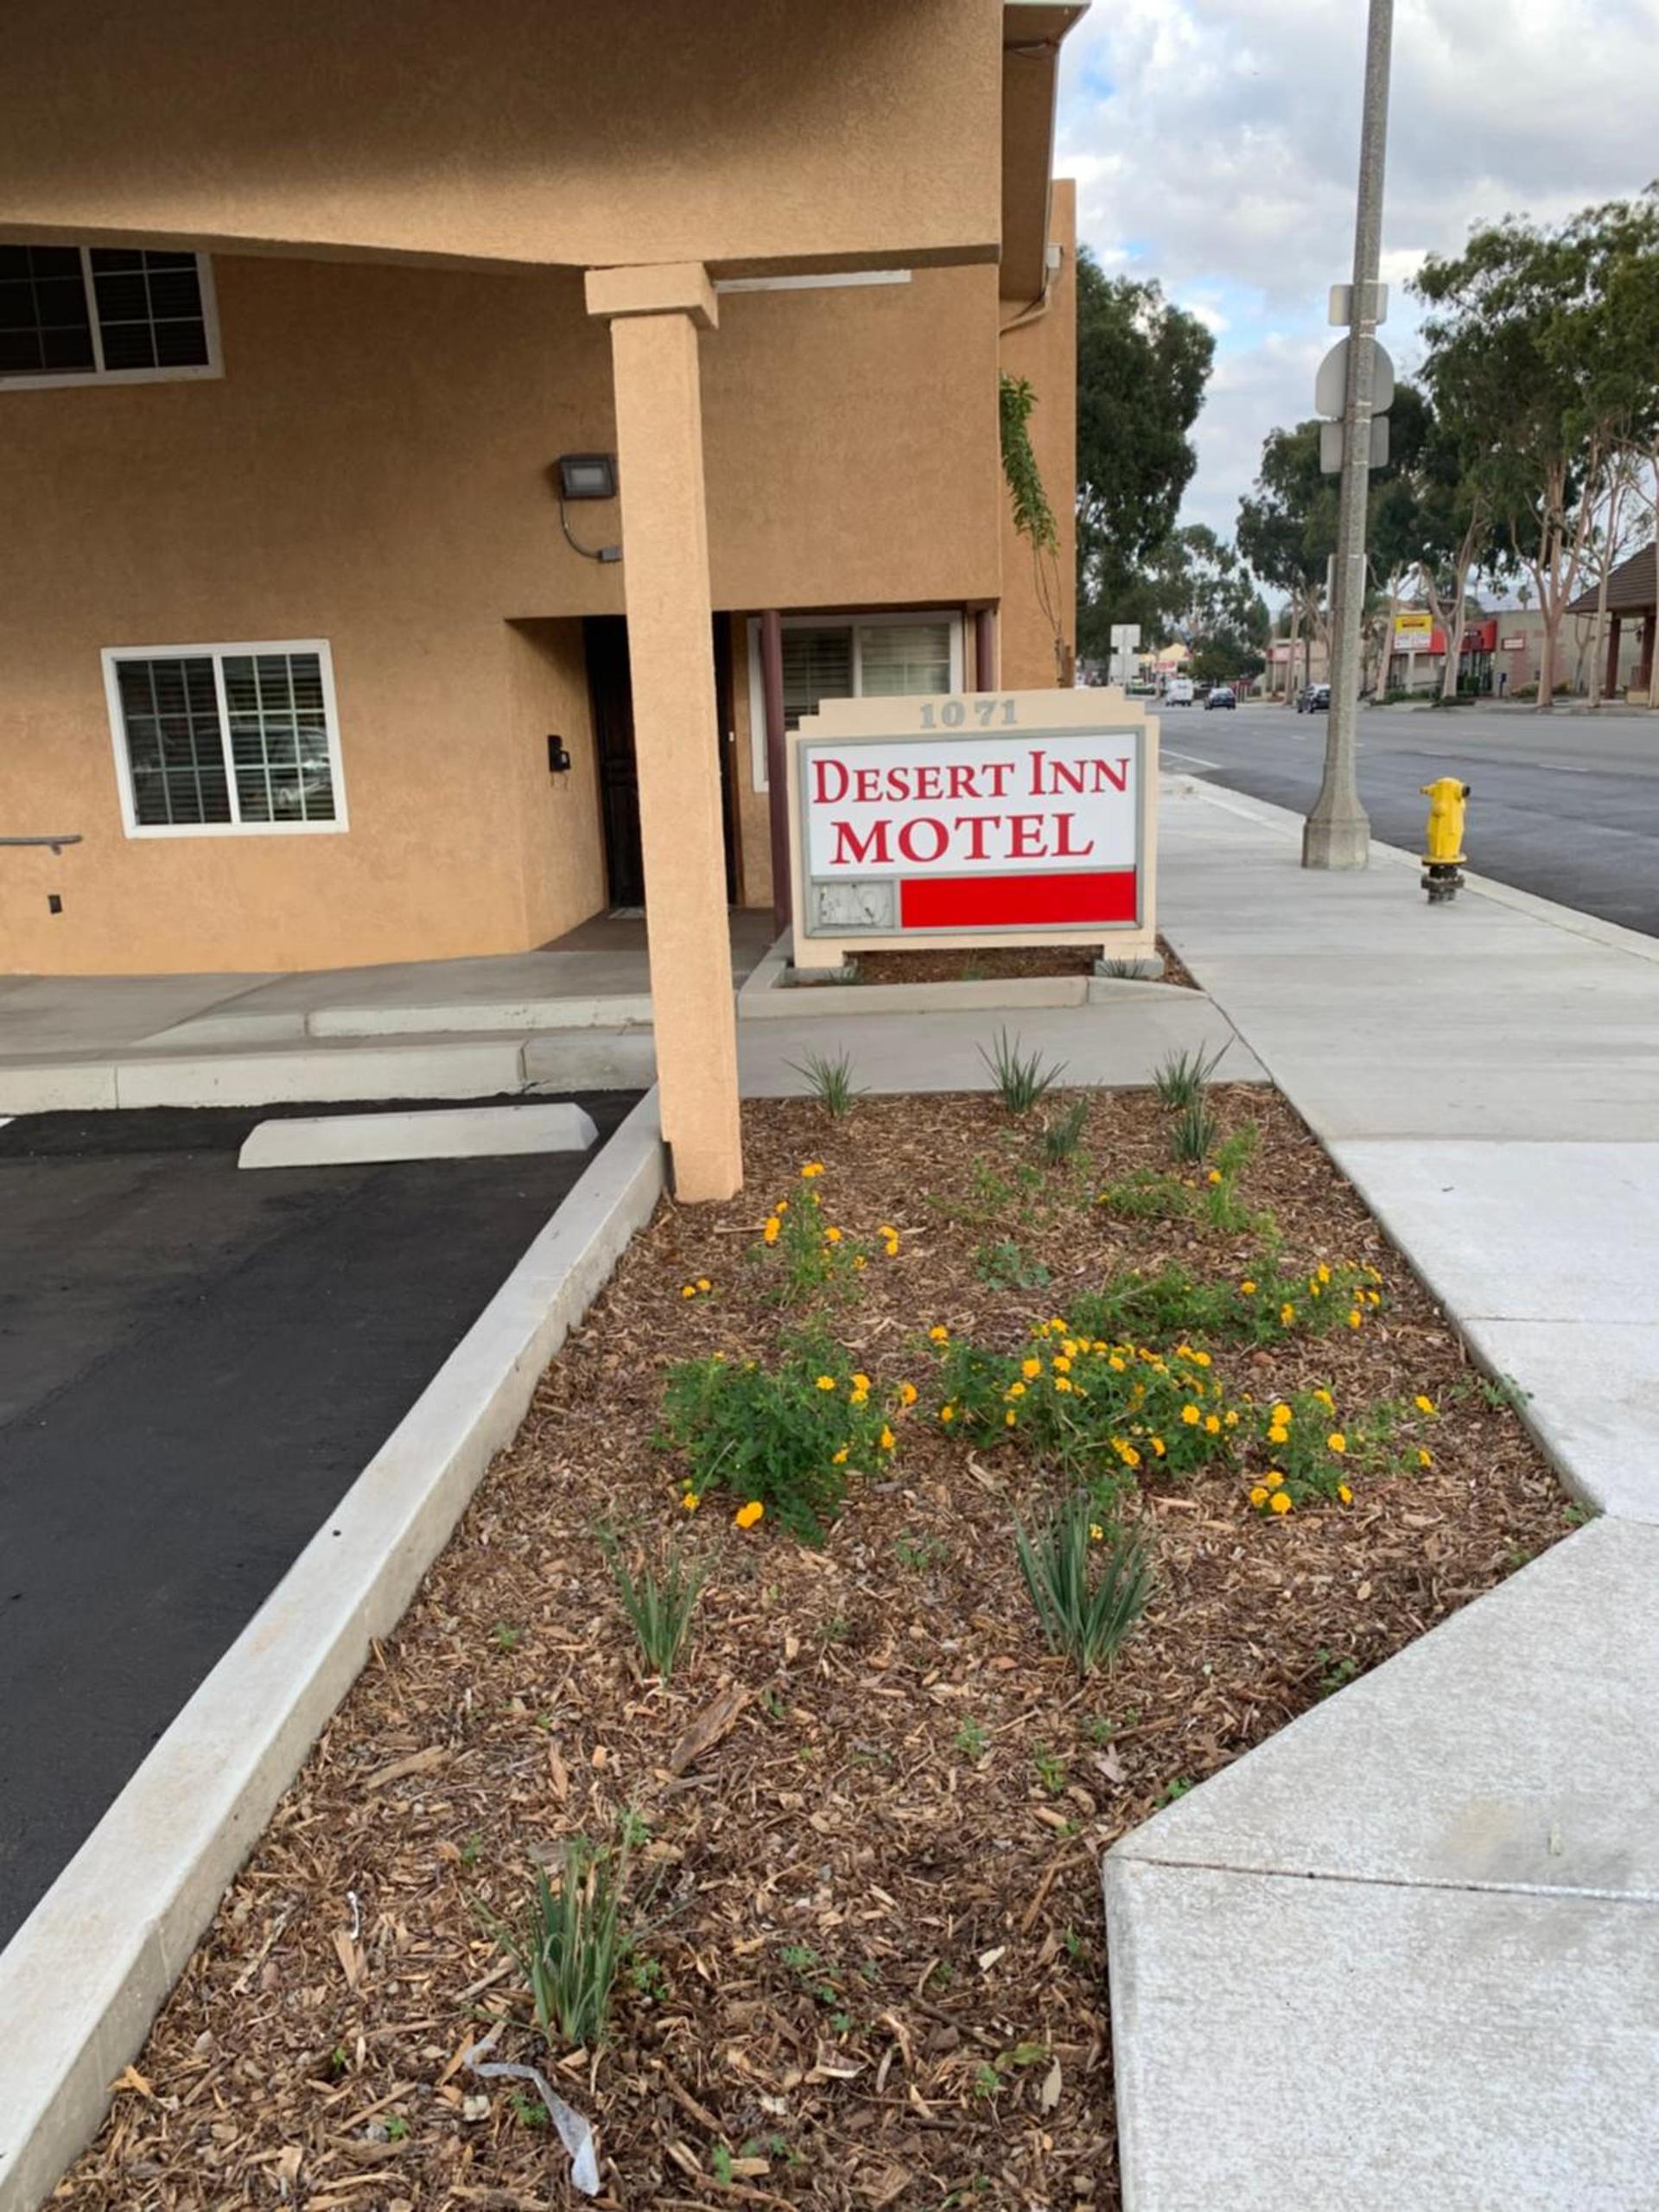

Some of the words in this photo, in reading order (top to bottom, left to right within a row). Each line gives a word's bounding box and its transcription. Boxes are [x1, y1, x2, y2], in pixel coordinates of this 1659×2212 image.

[919, 699, 1018, 728] 1071
[812, 760, 1015, 804] DESERT
[1028, 750, 1131, 795] INN
[830, 813, 1095, 864] MOTEL
